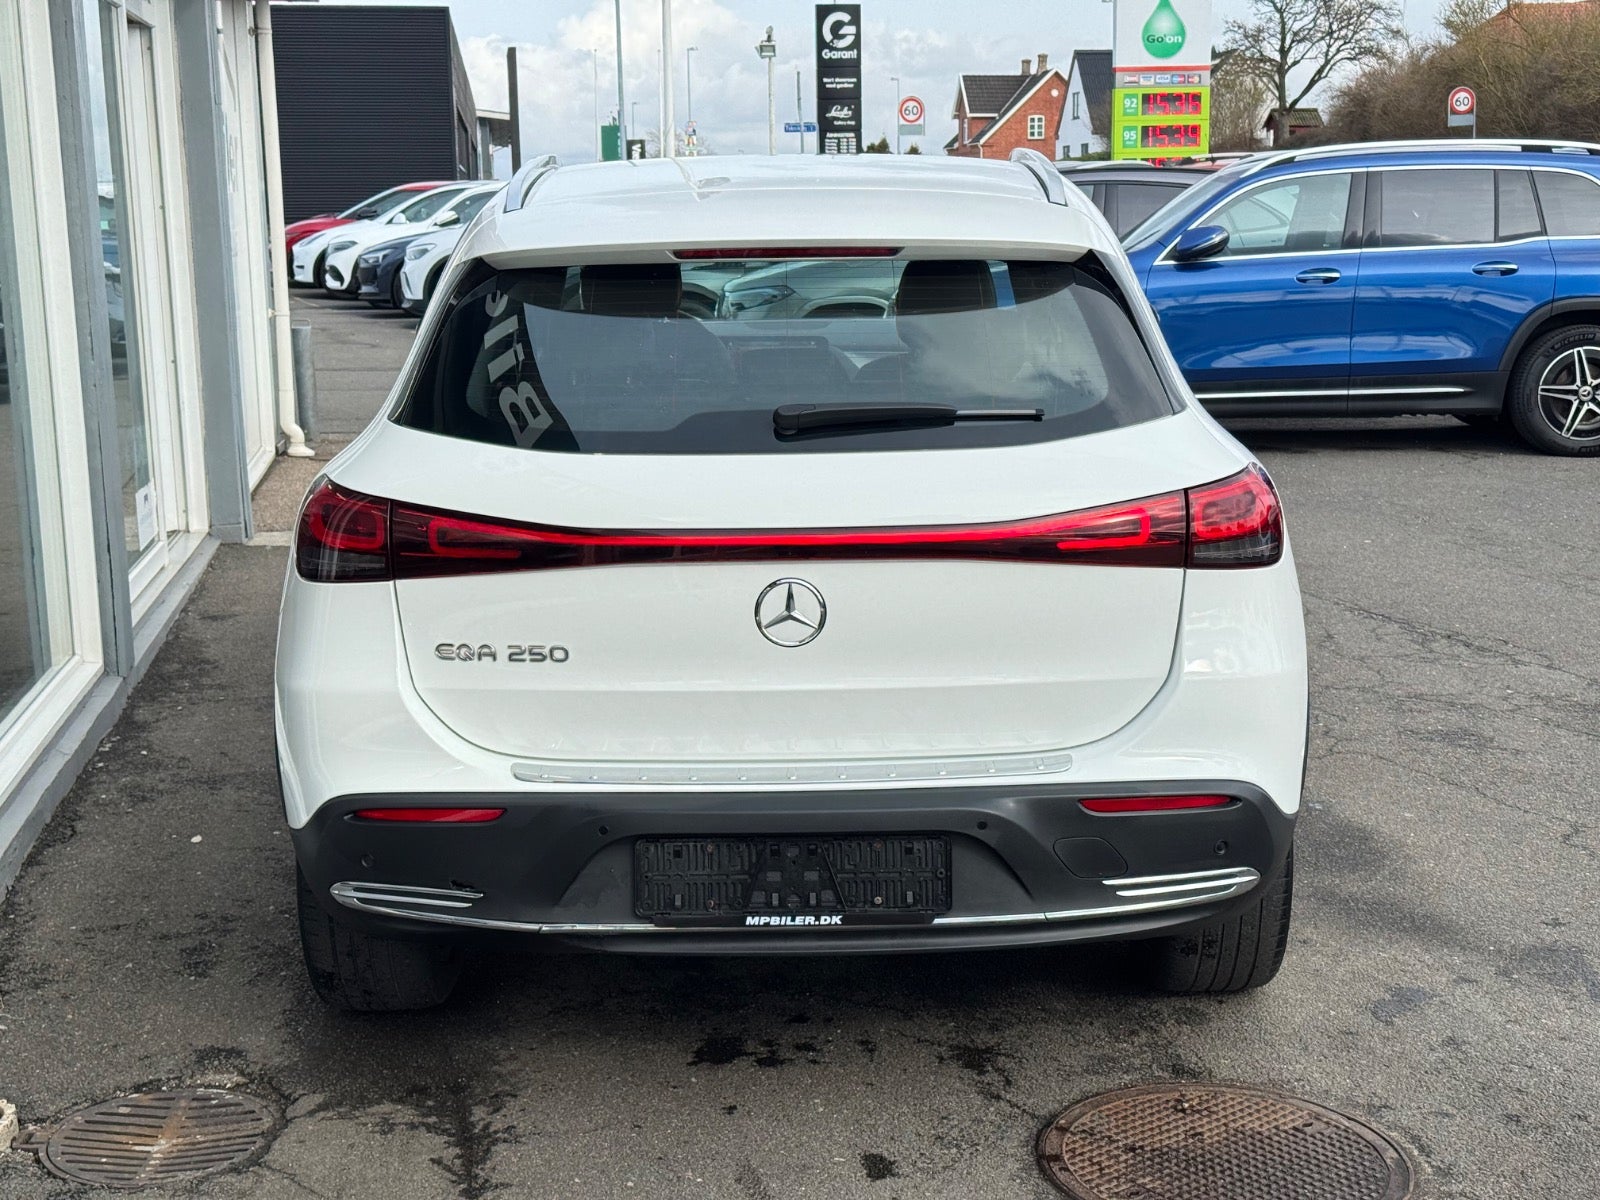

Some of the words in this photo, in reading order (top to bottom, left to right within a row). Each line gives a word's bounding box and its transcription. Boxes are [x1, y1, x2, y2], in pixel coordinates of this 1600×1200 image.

[1146, 34, 1182, 44] Go'on
[822, 49, 857, 59] Garant
[1124, 98, 1137, 108] 92
[1455, 97, 1470, 107] 60
[904, 105, 919, 116] 60
[1124, 130, 1137, 140] 95
[434, 643, 497, 662] EQA
[507, 645, 570, 663] 250
[745, 916, 843, 925] MPBILER.DK
